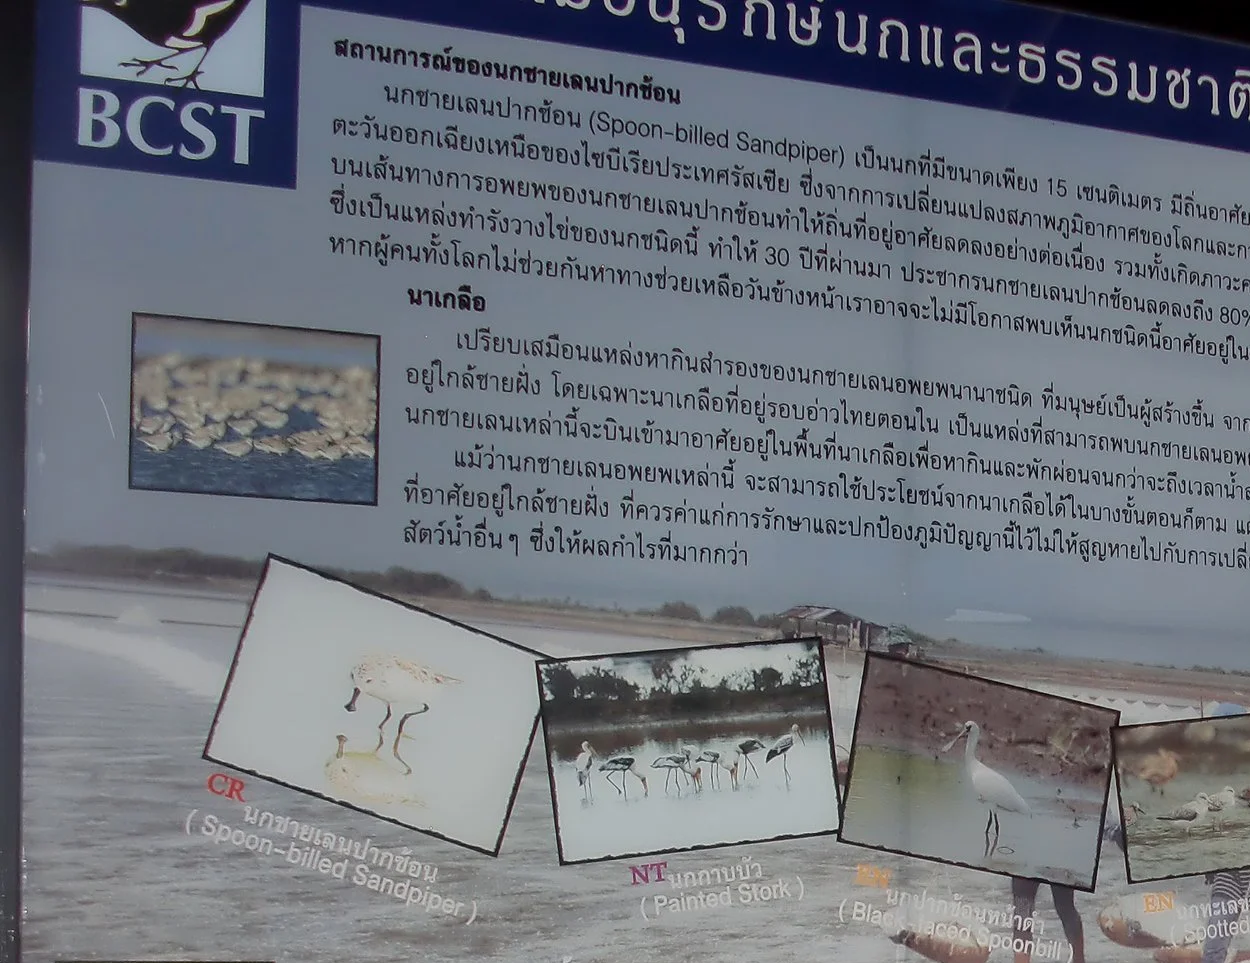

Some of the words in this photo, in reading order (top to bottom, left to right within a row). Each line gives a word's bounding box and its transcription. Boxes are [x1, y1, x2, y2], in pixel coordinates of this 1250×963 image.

[76, 86, 266, 167] BCST
[589, 110, 729, 149] (Spoon-billed
[736, 131, 845, 169] Sandpiper)
[855, 144, 1038, 193] เป็นนกที่มีขนาดเพียง
[1047, 177, 1068, 198] 15
[1077, 183, 1162, 212] เซนติเมตร
[708, 234, 759, 263] ทำให้
[764, 246, 790, 267] 30
[798, 243, 891, 280] ปีที่ผ่านมา
[407, 284, 486, 312] นาเกลือ
[406, 358, 541, 395] อยู่ใกล้ชายฝั่ง
[207, 773, 246, 803] CR
[201, 814, 348, 880] Spoon-billed
[352, 864, 465, 918] Sandpiper
[629, 861, 668, 886] NT
[653, 886, 732, 916] Painted
[738, 877, 792, 904] Stork
